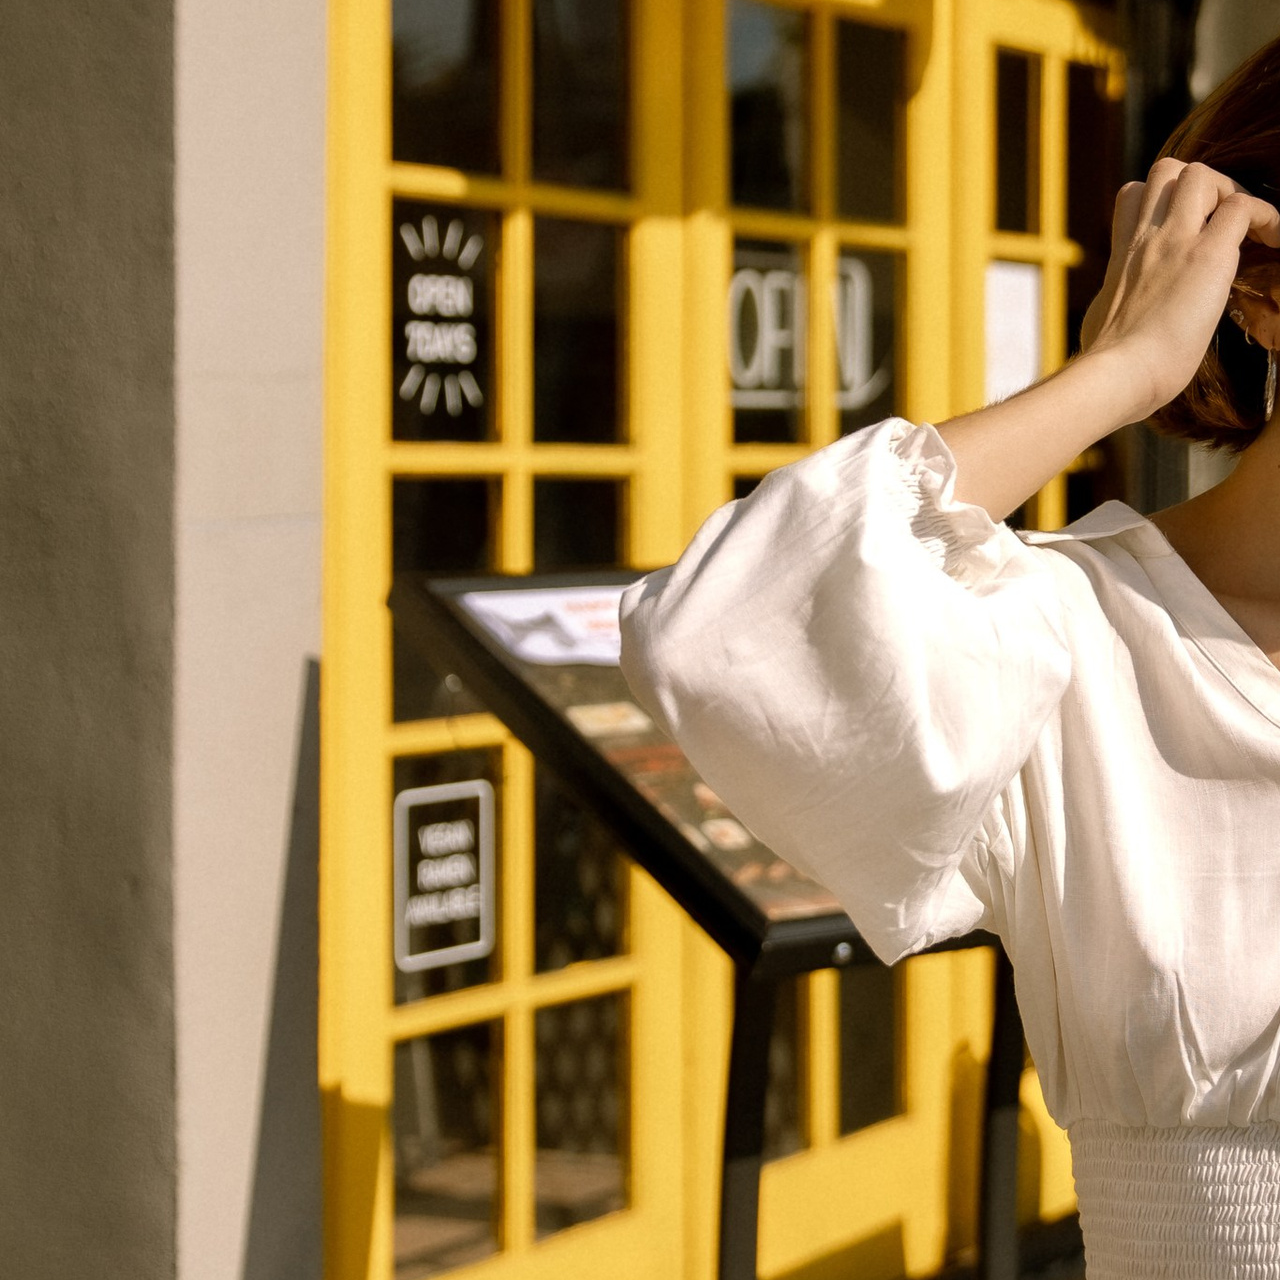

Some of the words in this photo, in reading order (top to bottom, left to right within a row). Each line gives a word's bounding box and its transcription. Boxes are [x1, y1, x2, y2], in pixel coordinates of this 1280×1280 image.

[408, 274, 474, 317] OPEN
[418, 818, 475, 858] VEGAN
[417, 852, 477, 892] RAMEN
